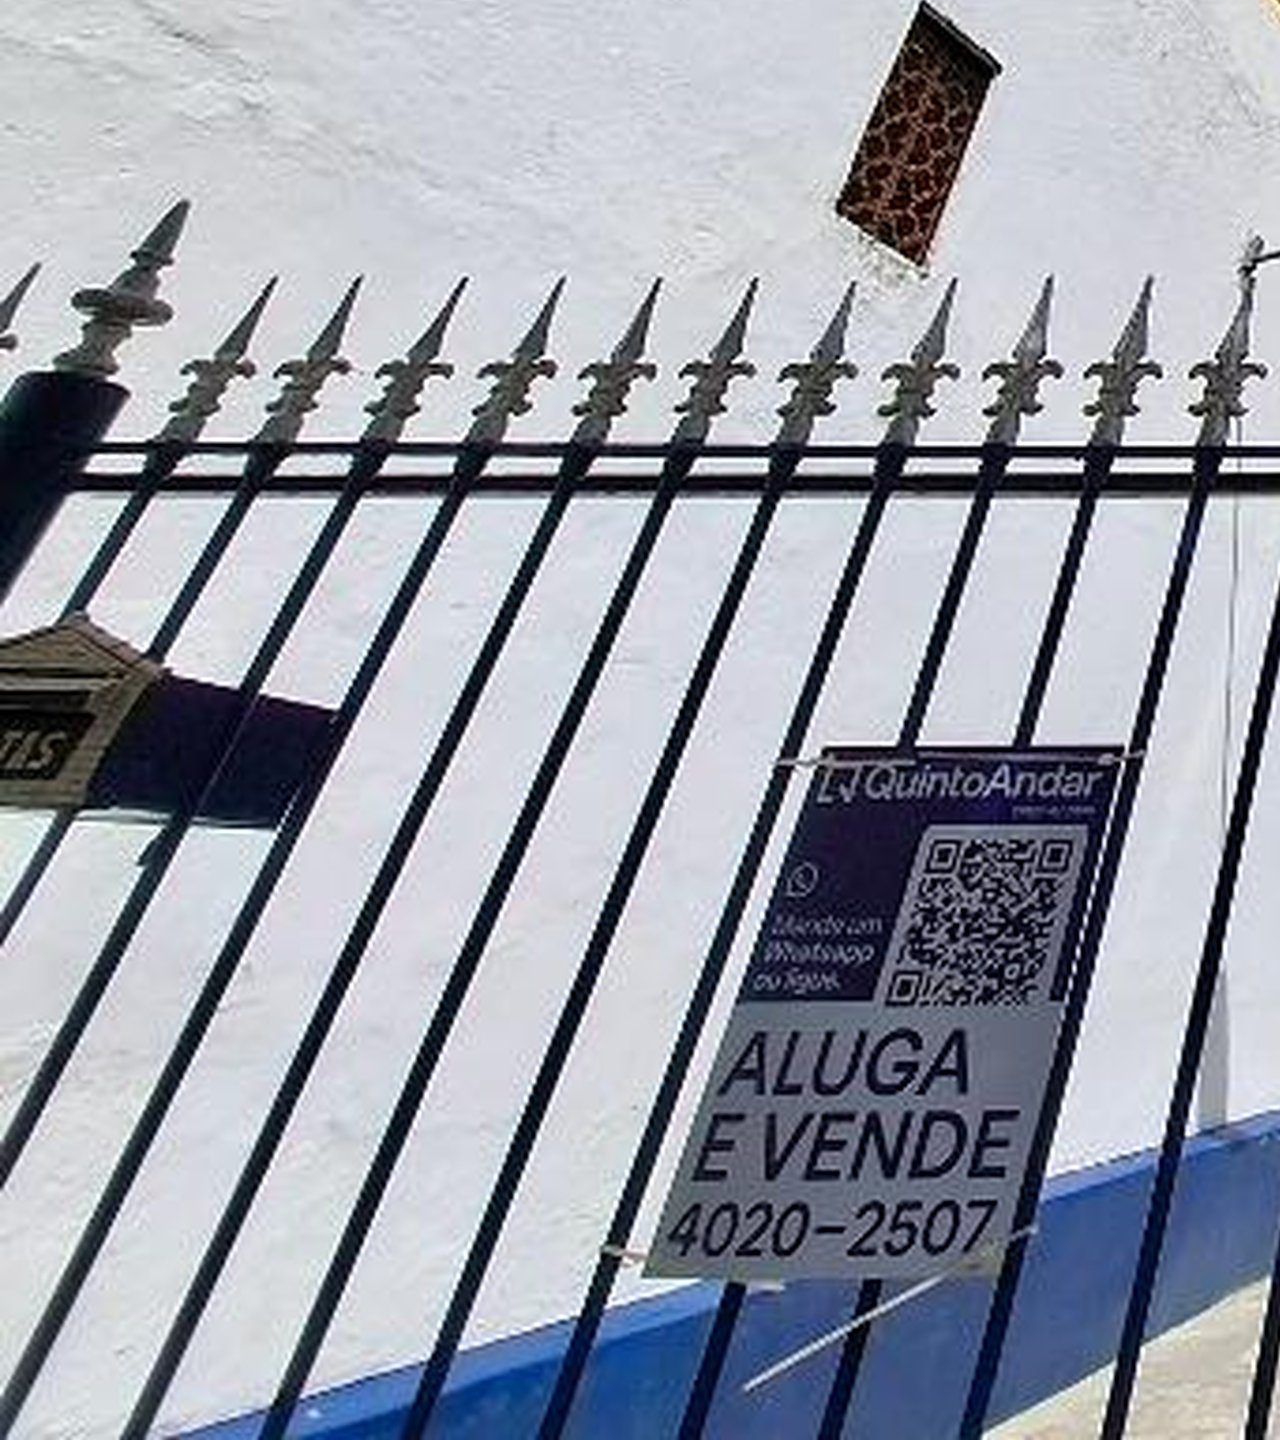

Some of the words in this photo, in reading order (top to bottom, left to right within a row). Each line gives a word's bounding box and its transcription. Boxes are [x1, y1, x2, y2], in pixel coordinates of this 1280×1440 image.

[864, 762, 1104, 800] QuintoAndar
[717, 1026, 970, 1097] ALUGA
[691, 1112, 745, 1182] E
[761, 1109, 1021, 1181] VENDE
[666, 1199, 999, 1258] 4020-2507
